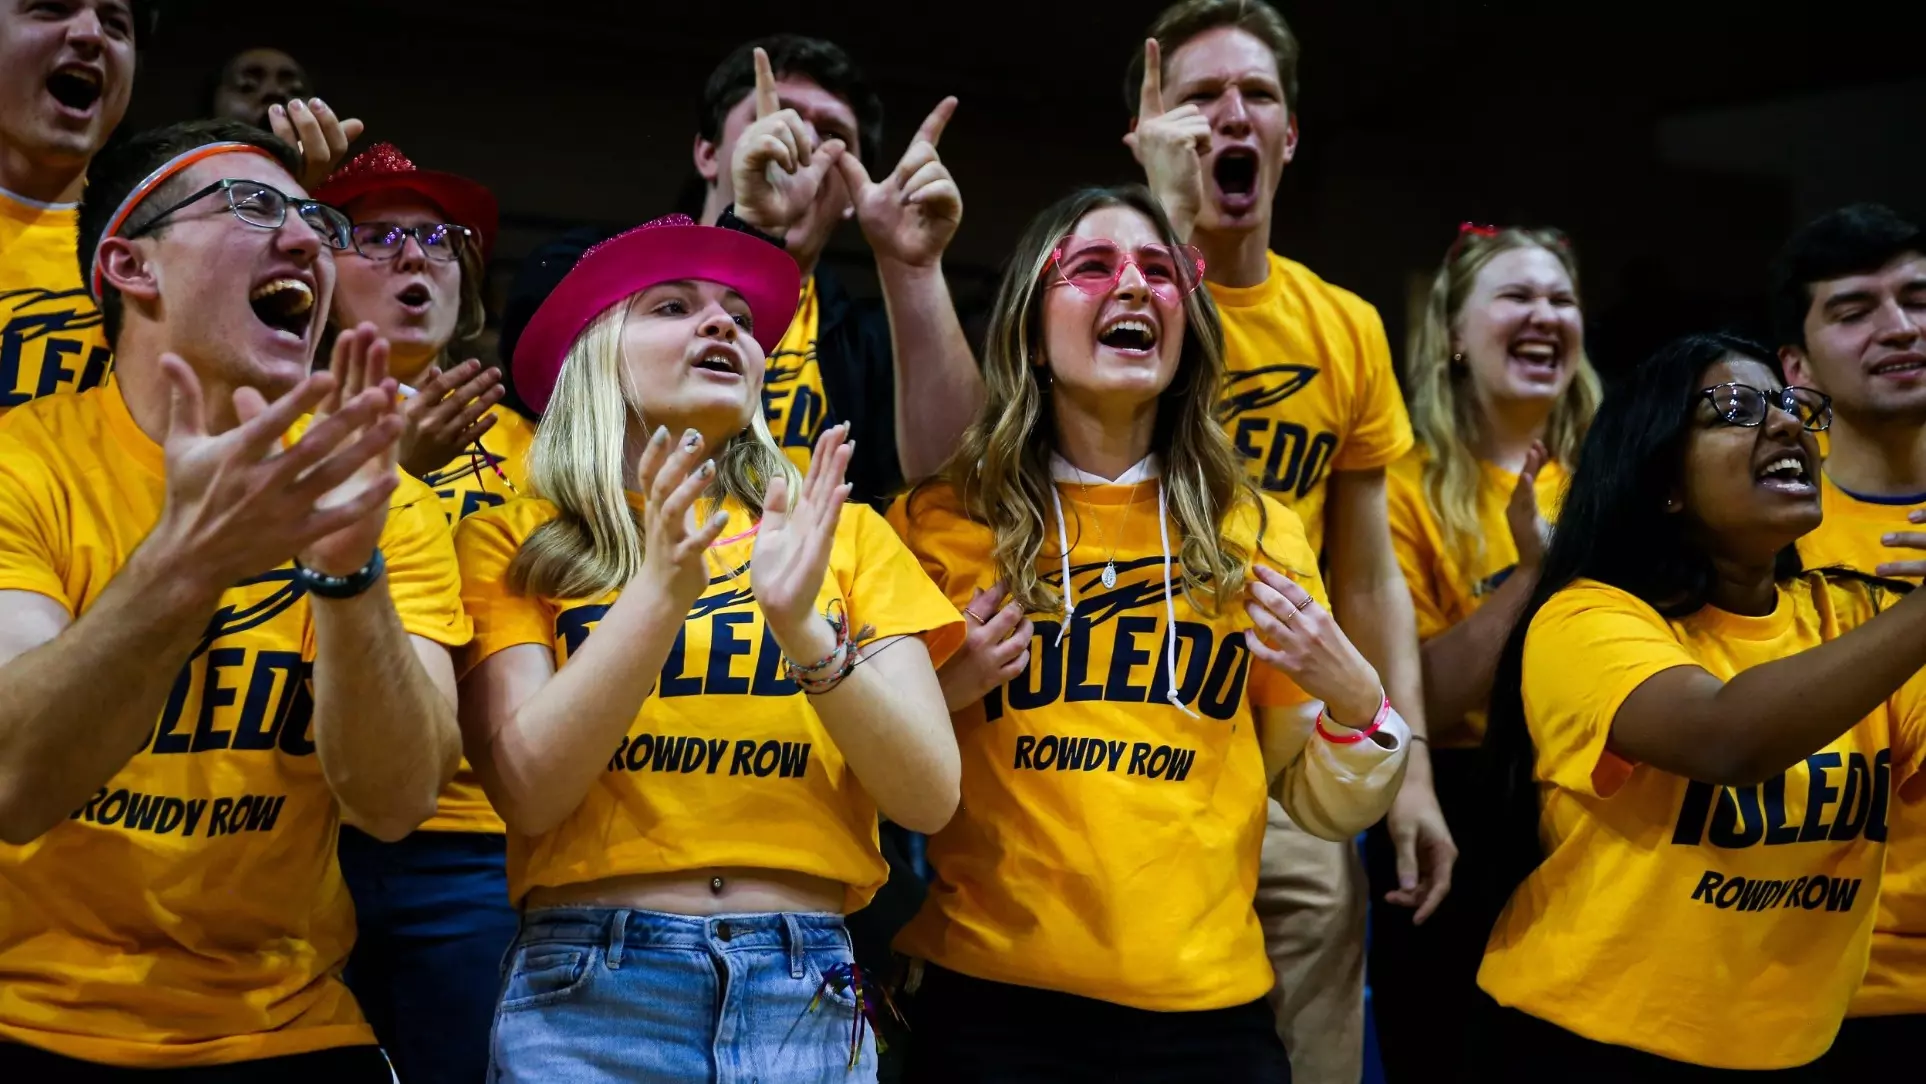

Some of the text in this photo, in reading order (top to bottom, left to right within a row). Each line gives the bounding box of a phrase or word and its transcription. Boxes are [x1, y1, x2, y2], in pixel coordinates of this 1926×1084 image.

[556, 604, 803, 698] TLED
[983, 615, 1250, 722] OLEDO
[729, 739, 811, 778] ROW
[1013, 734, 1196, 781] ROWDY ROW
[207, 794, 287, 837] ROW
[1691, 870, 1862, 912] ROWDY ROW
